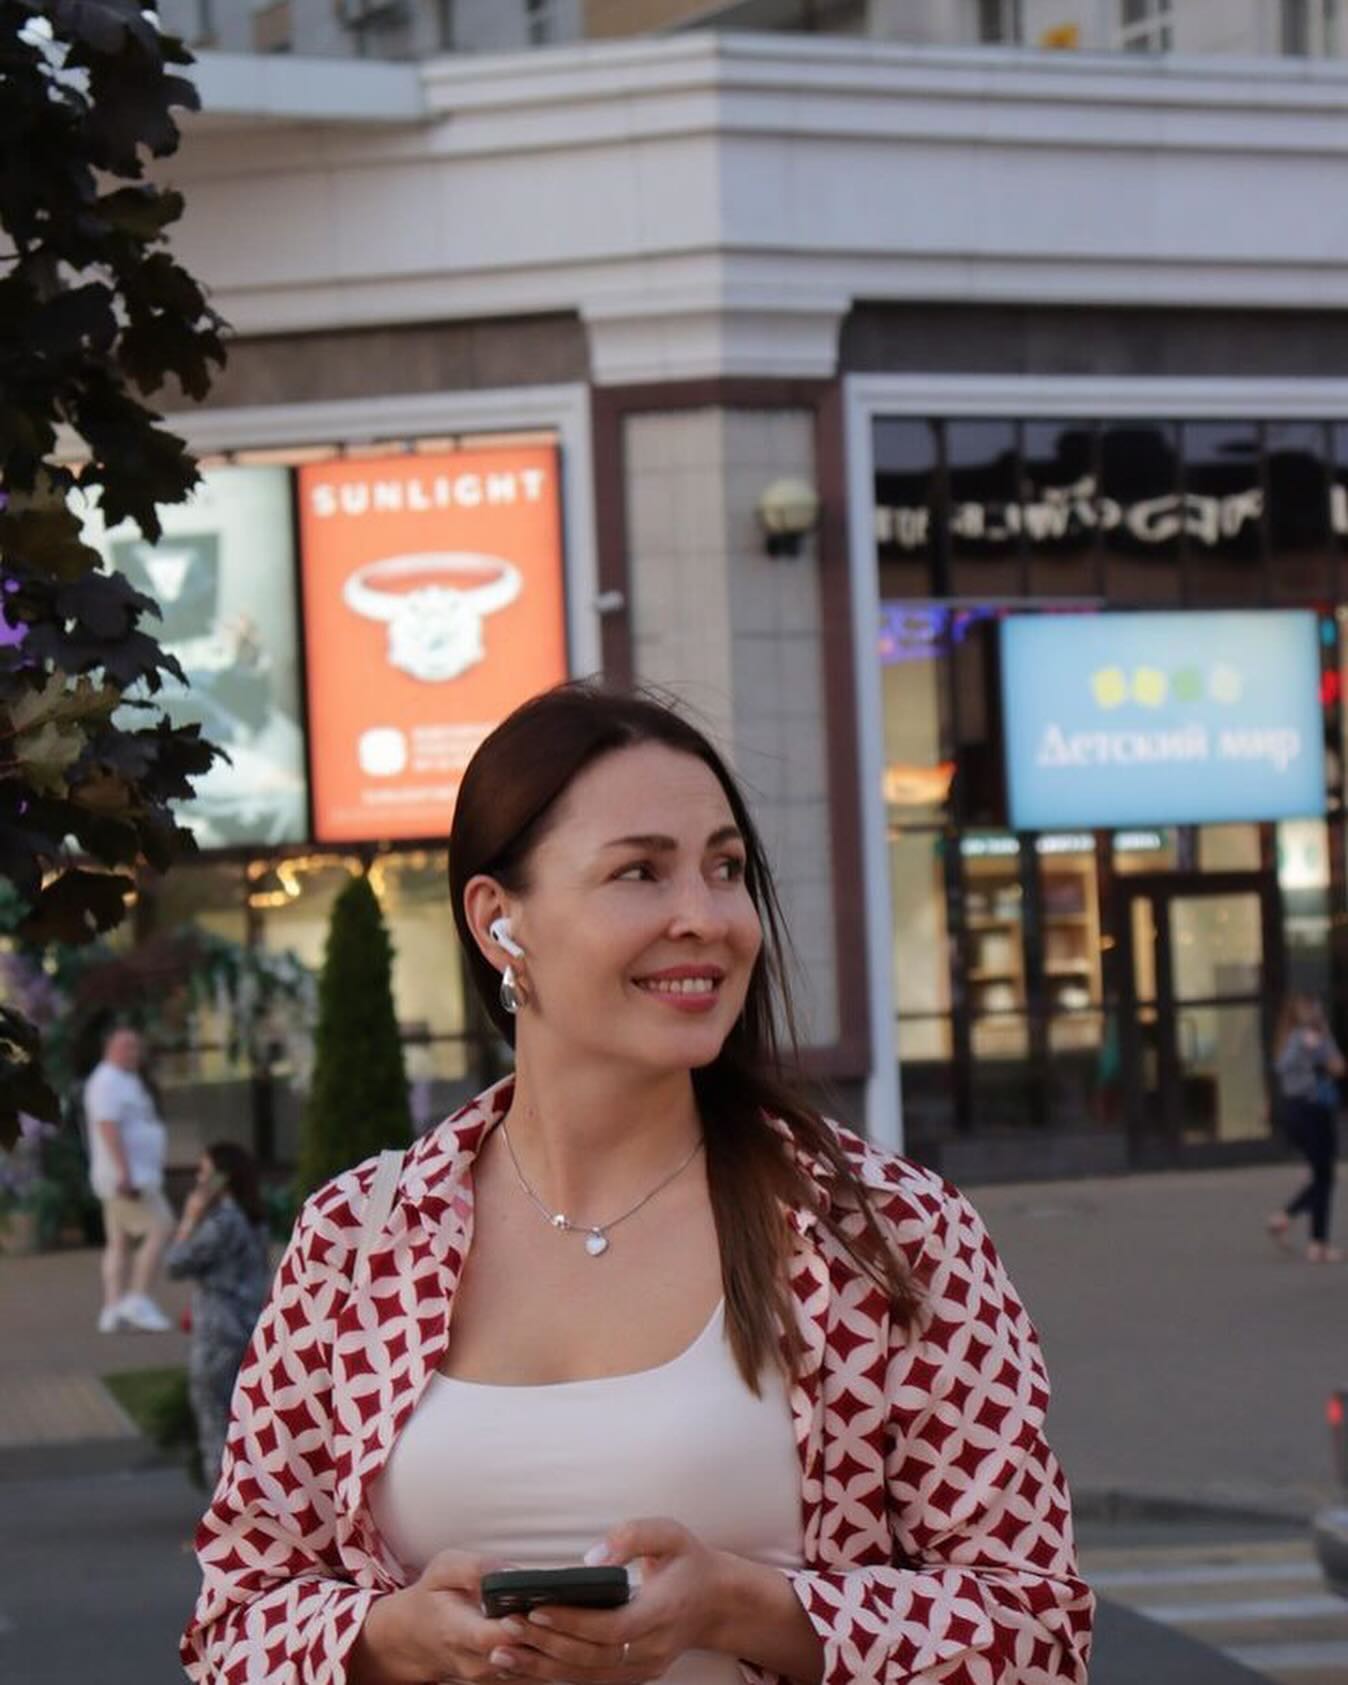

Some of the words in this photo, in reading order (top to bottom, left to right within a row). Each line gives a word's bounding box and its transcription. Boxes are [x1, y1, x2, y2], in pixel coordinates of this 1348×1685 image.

[311, 469, 545, 517] SUNLIGHT
[1038, 724, 1208, 768] Детский
[1219, 728, 1299, 772] мир
